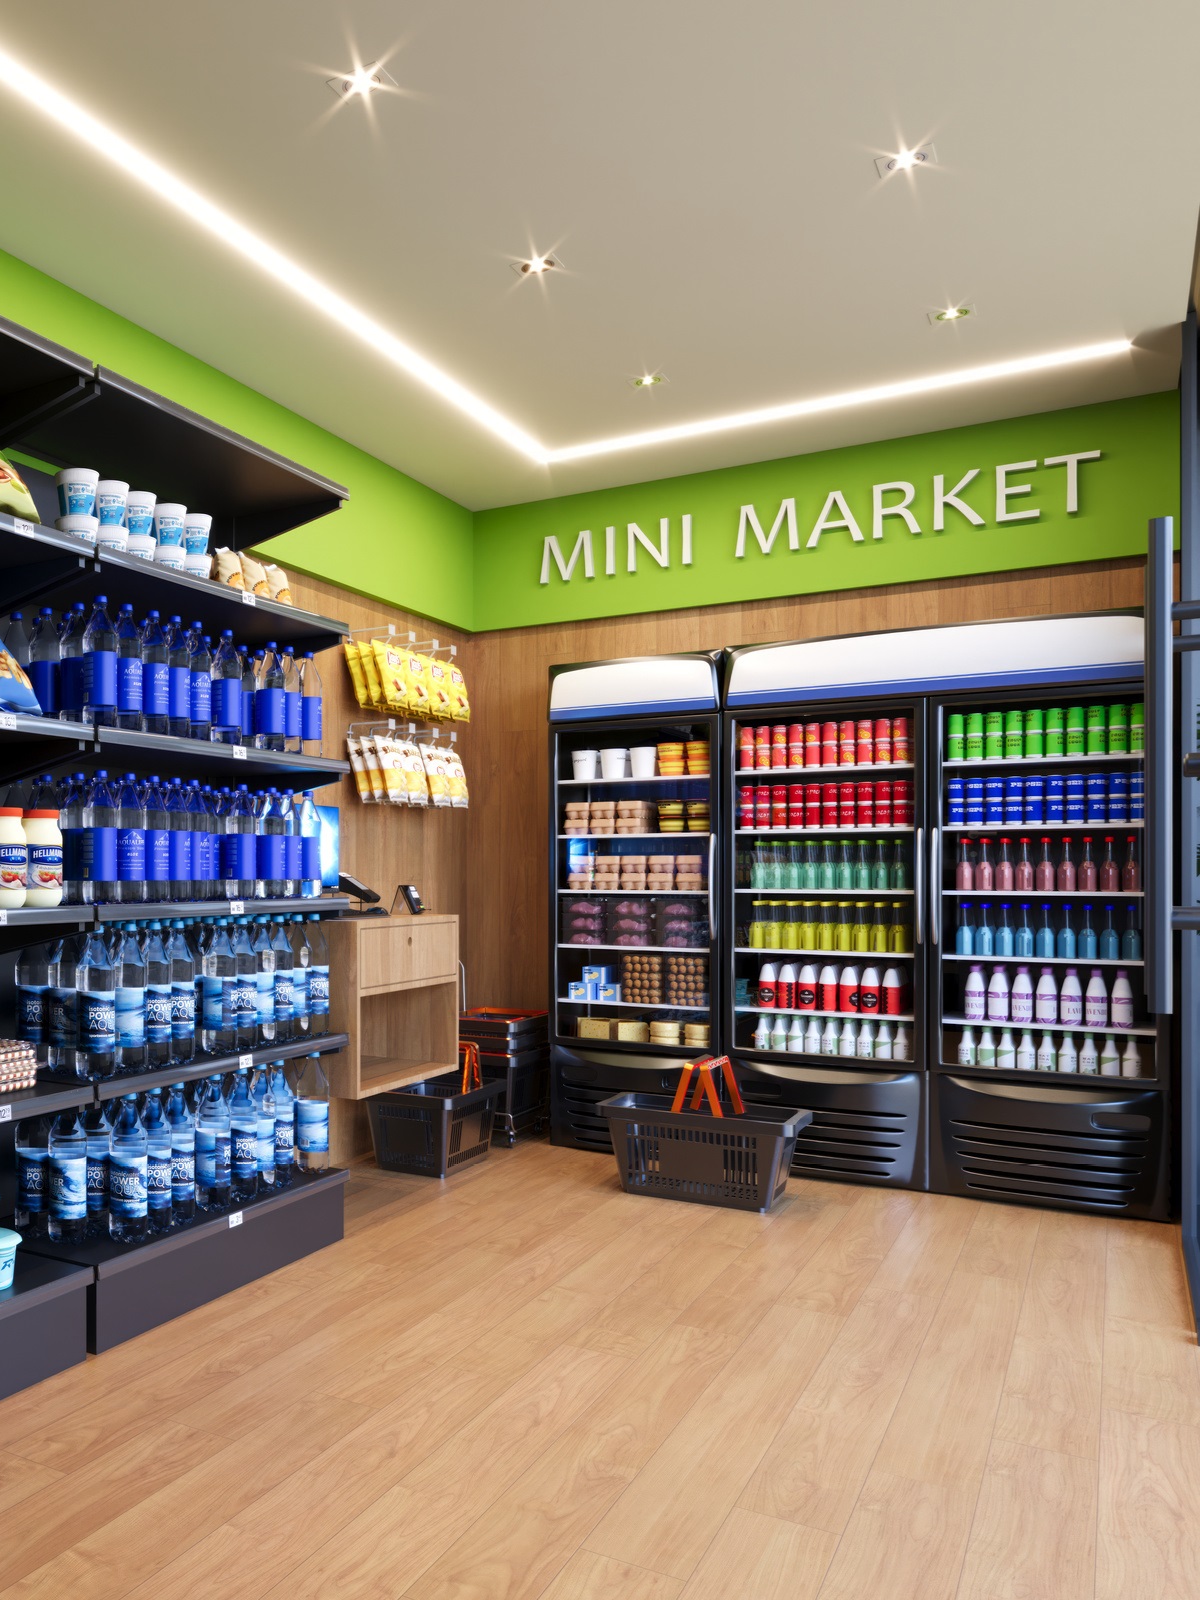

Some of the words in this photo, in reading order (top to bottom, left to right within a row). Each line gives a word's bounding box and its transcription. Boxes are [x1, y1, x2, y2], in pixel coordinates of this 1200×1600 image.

[539, 513, 693, 585] MINI
[735, 449, 1102, 560] MARKET
[89, 1012, 115, 1020] POWE
